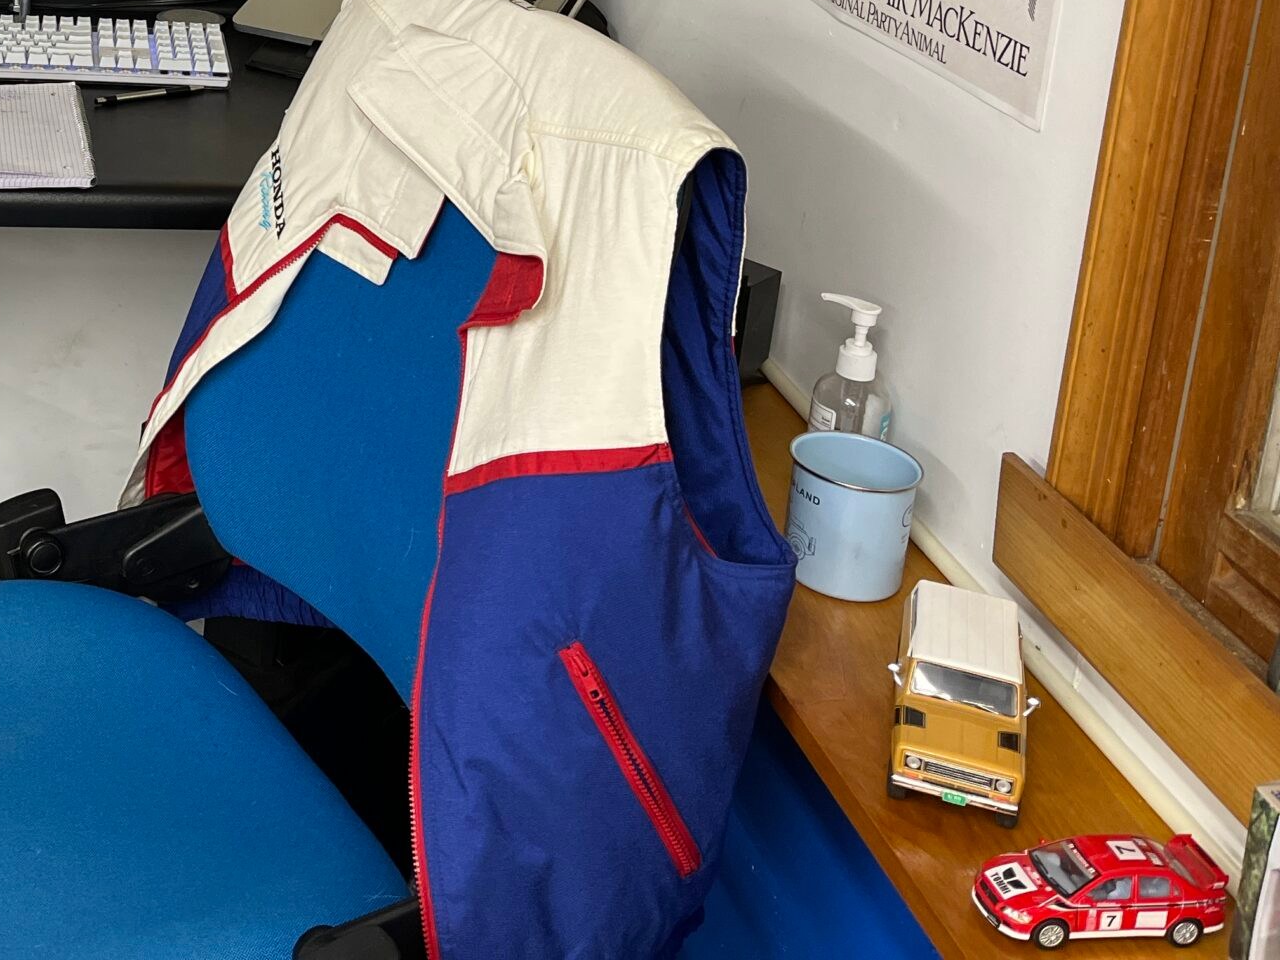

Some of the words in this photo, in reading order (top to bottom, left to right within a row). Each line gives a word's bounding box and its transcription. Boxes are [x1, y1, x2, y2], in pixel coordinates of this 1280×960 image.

[866, 2, 903, 37] PARTY
[899, 23, 947, 65] ANIMAL
[271, 145, 286, 240] HONDA
[791, 478, 821, 506] LAND
[1106, 914, 1118, 928] 7
